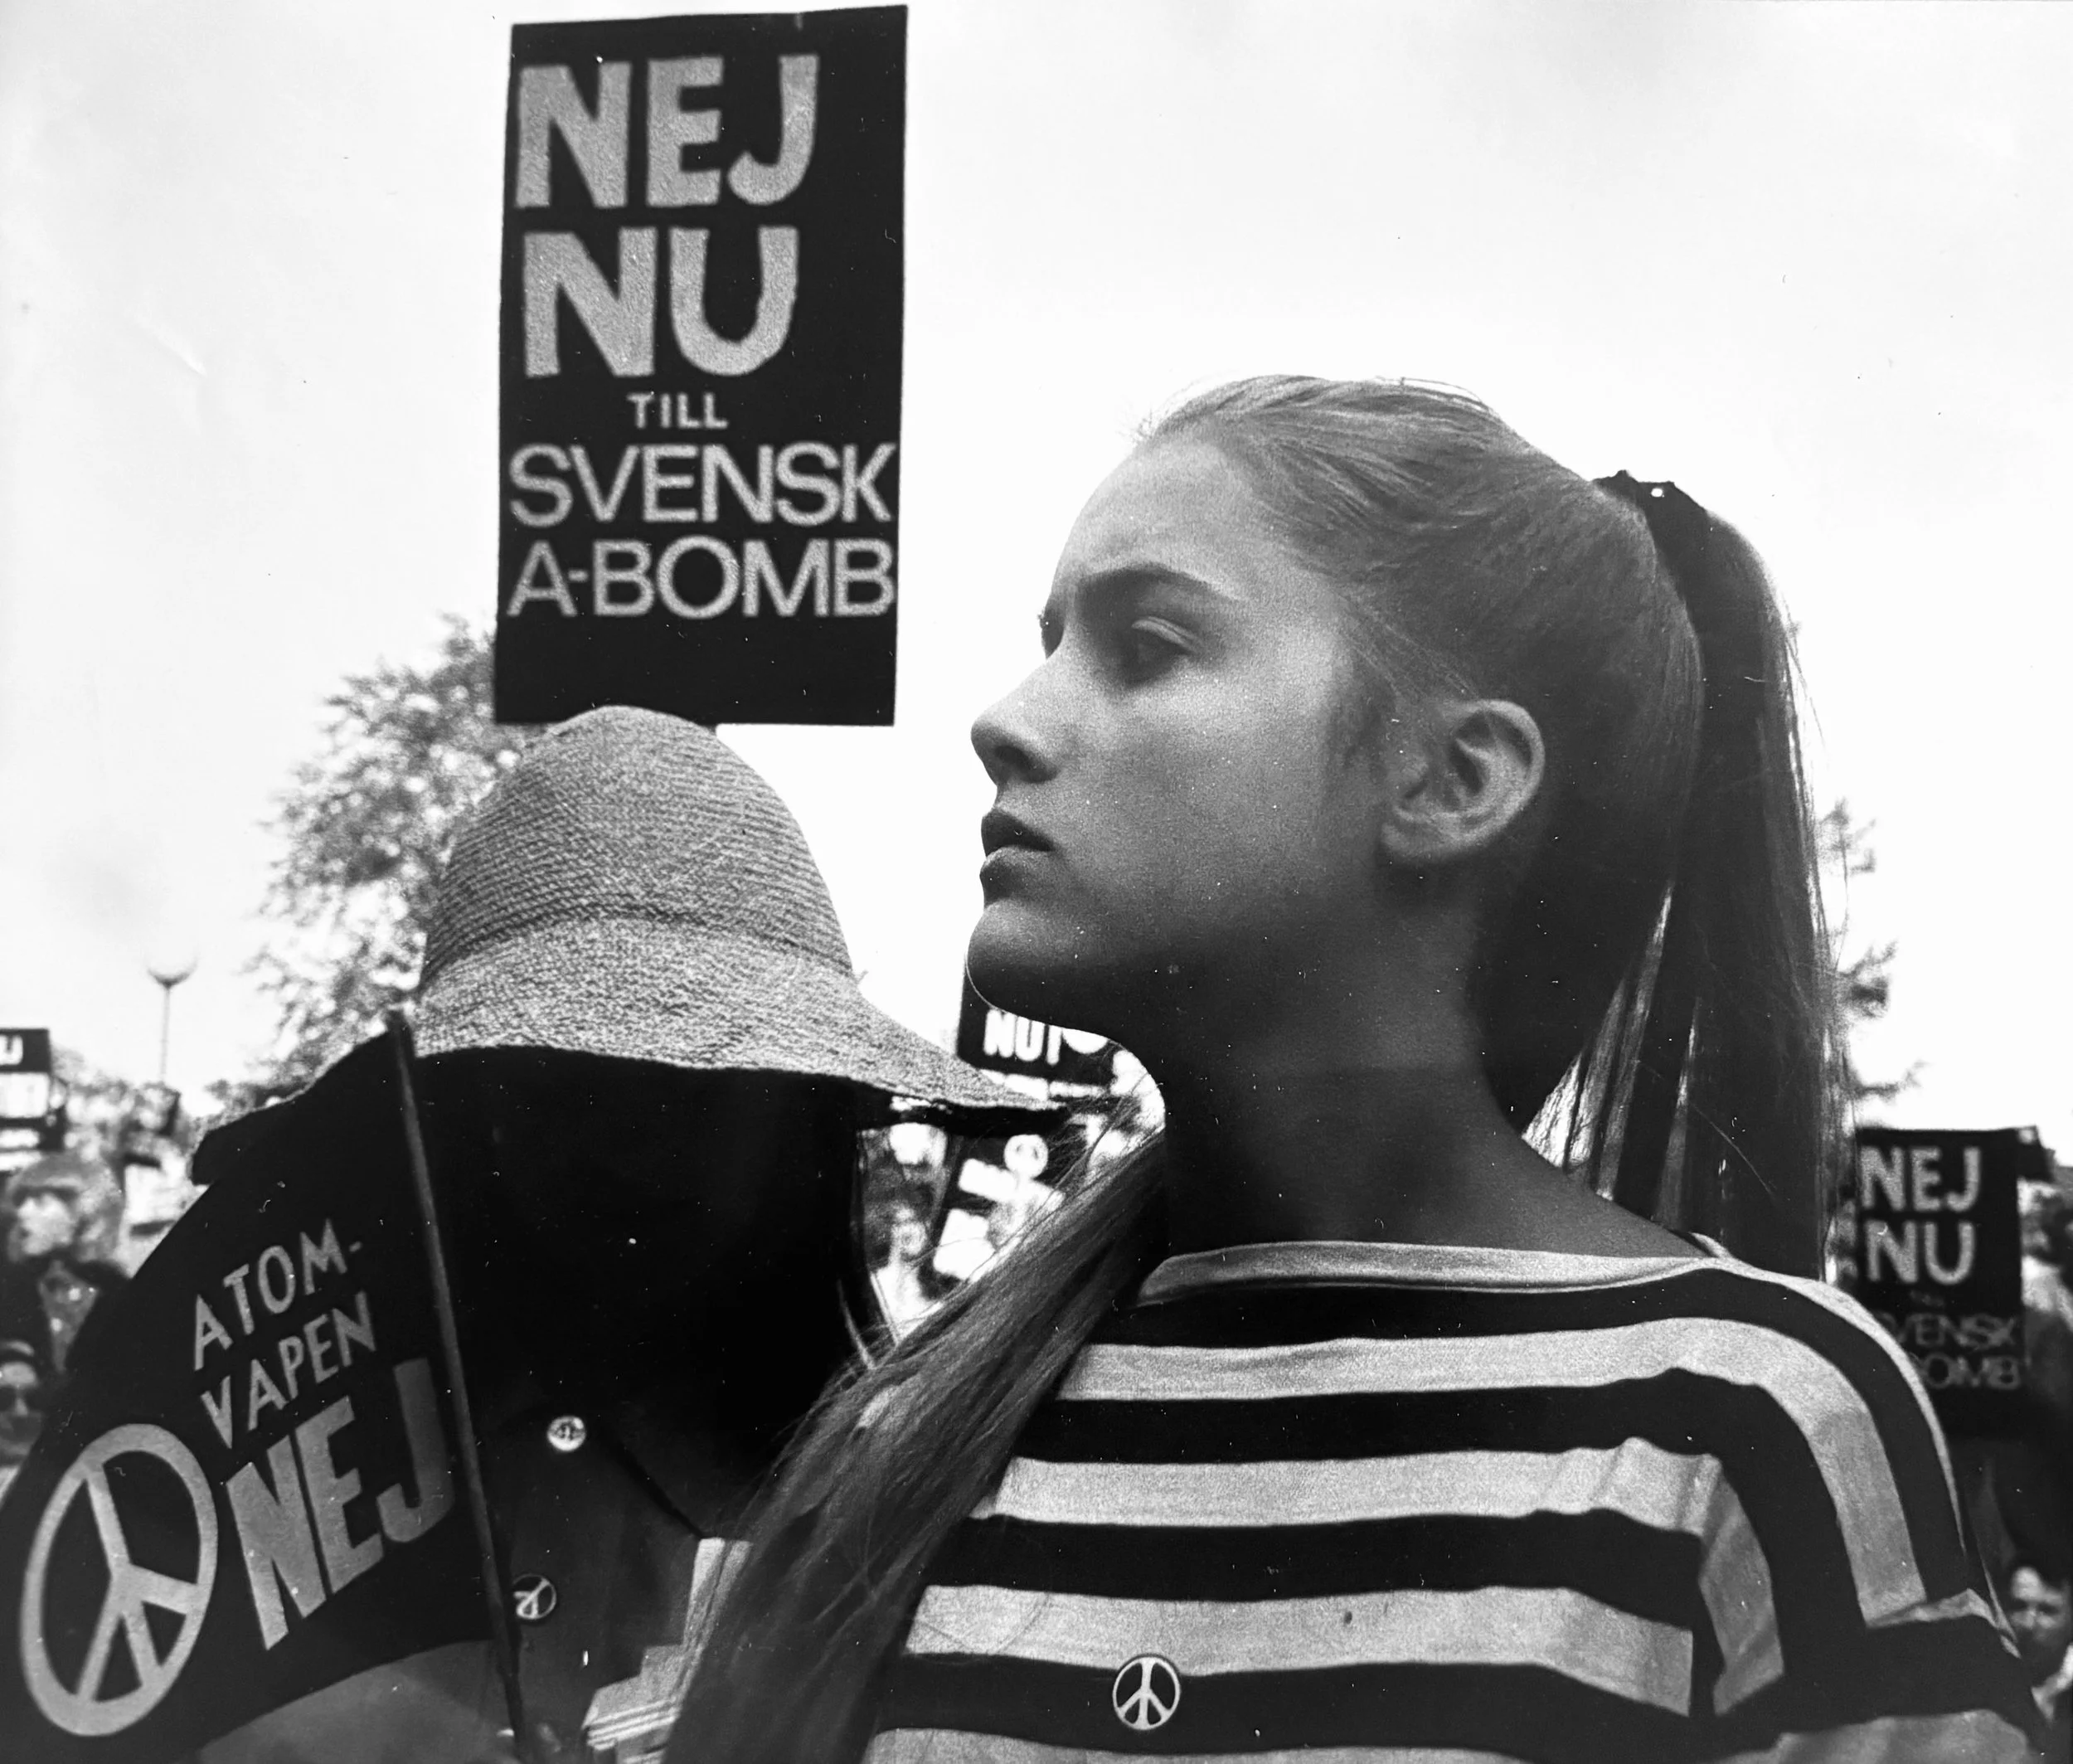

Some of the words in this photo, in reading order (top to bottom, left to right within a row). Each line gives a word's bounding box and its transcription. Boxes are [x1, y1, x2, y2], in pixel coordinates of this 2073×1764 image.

[515, 54, 818, 208] NEJ
[524, 226, 798, 377] NU
[627, 392, 728, 429] TILL
[509, 442, 896, 527] SVENSK
[507, 535, 896, 618] A-BOMB
[1860, 1146, 1982, 1212] NEJ
[194, 1218, 362, 1371] ATOM-
[1866, 1220, 1975, 1285] NU
[201, 1291, 377, 1449] VAPEN
[226, 1358, 454, 1650] NEJ
